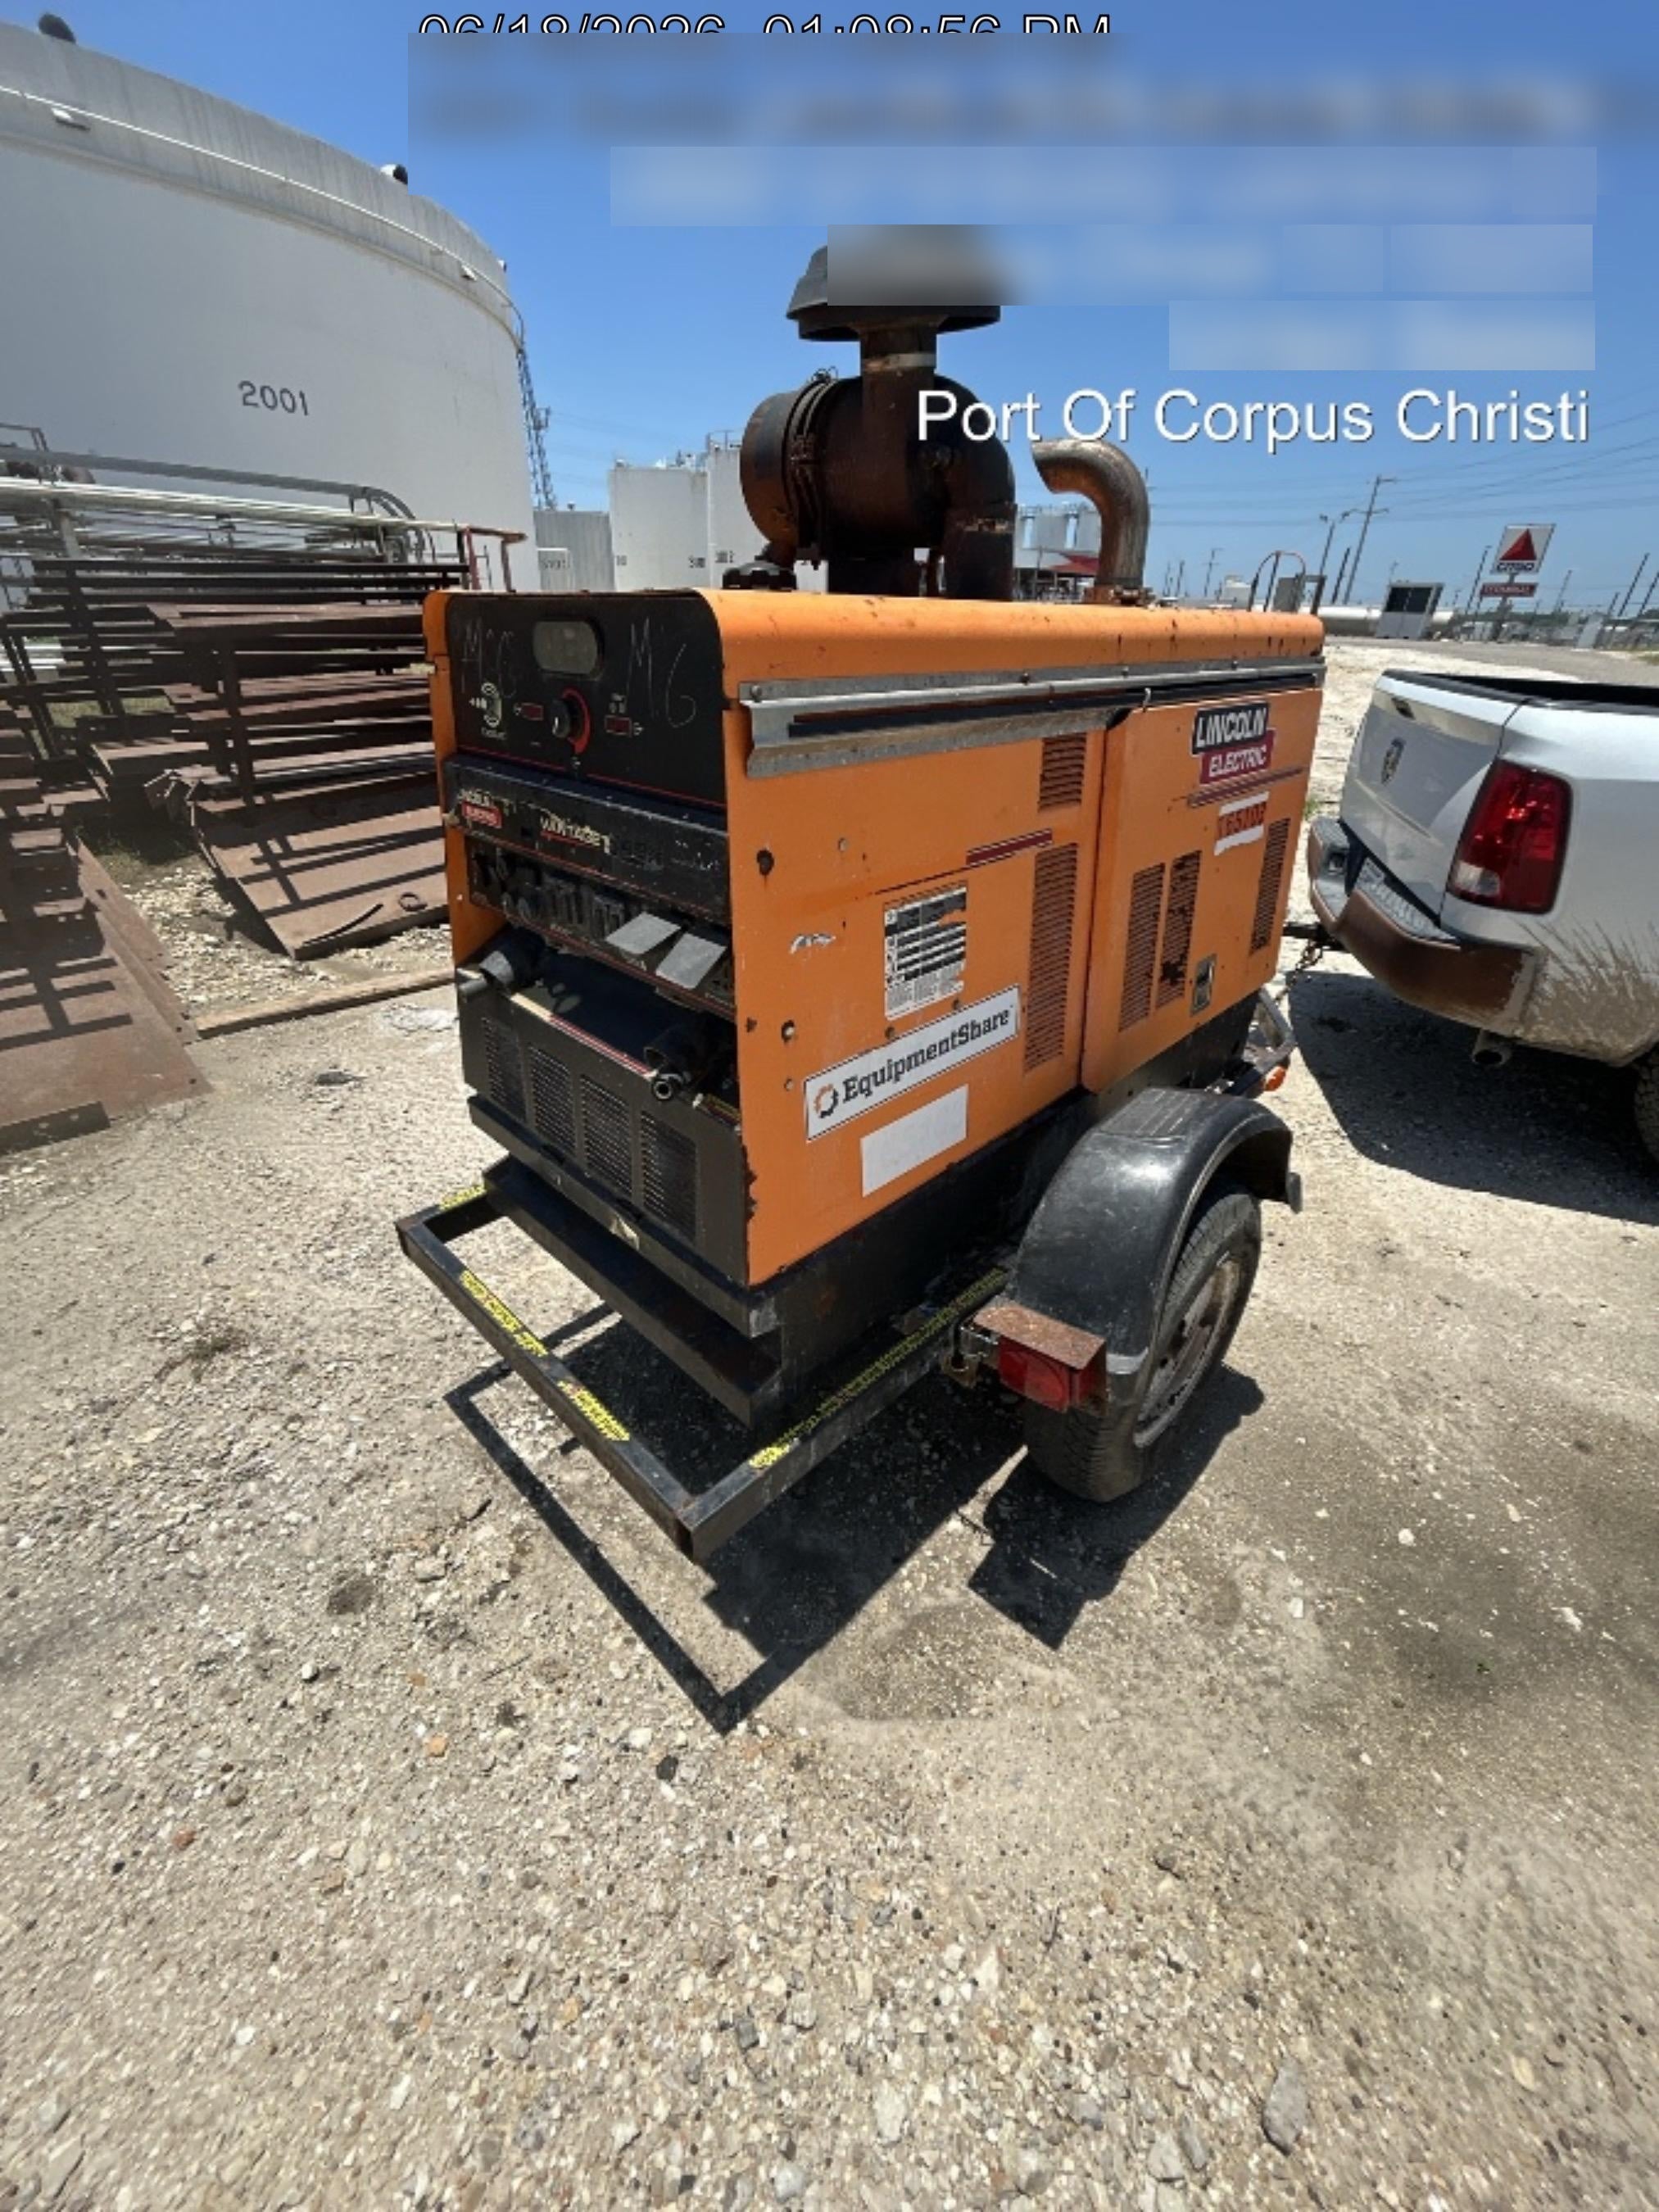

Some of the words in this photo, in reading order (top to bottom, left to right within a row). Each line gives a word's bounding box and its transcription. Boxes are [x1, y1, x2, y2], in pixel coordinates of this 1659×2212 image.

[238, 379, 308, 416] 2001
[1196, 707, 1267, 748] LINCOLN
[1208, 744, 1267, 777] ELECTRIC
[841, 1008, 1010, 1104] EquipmentShare
